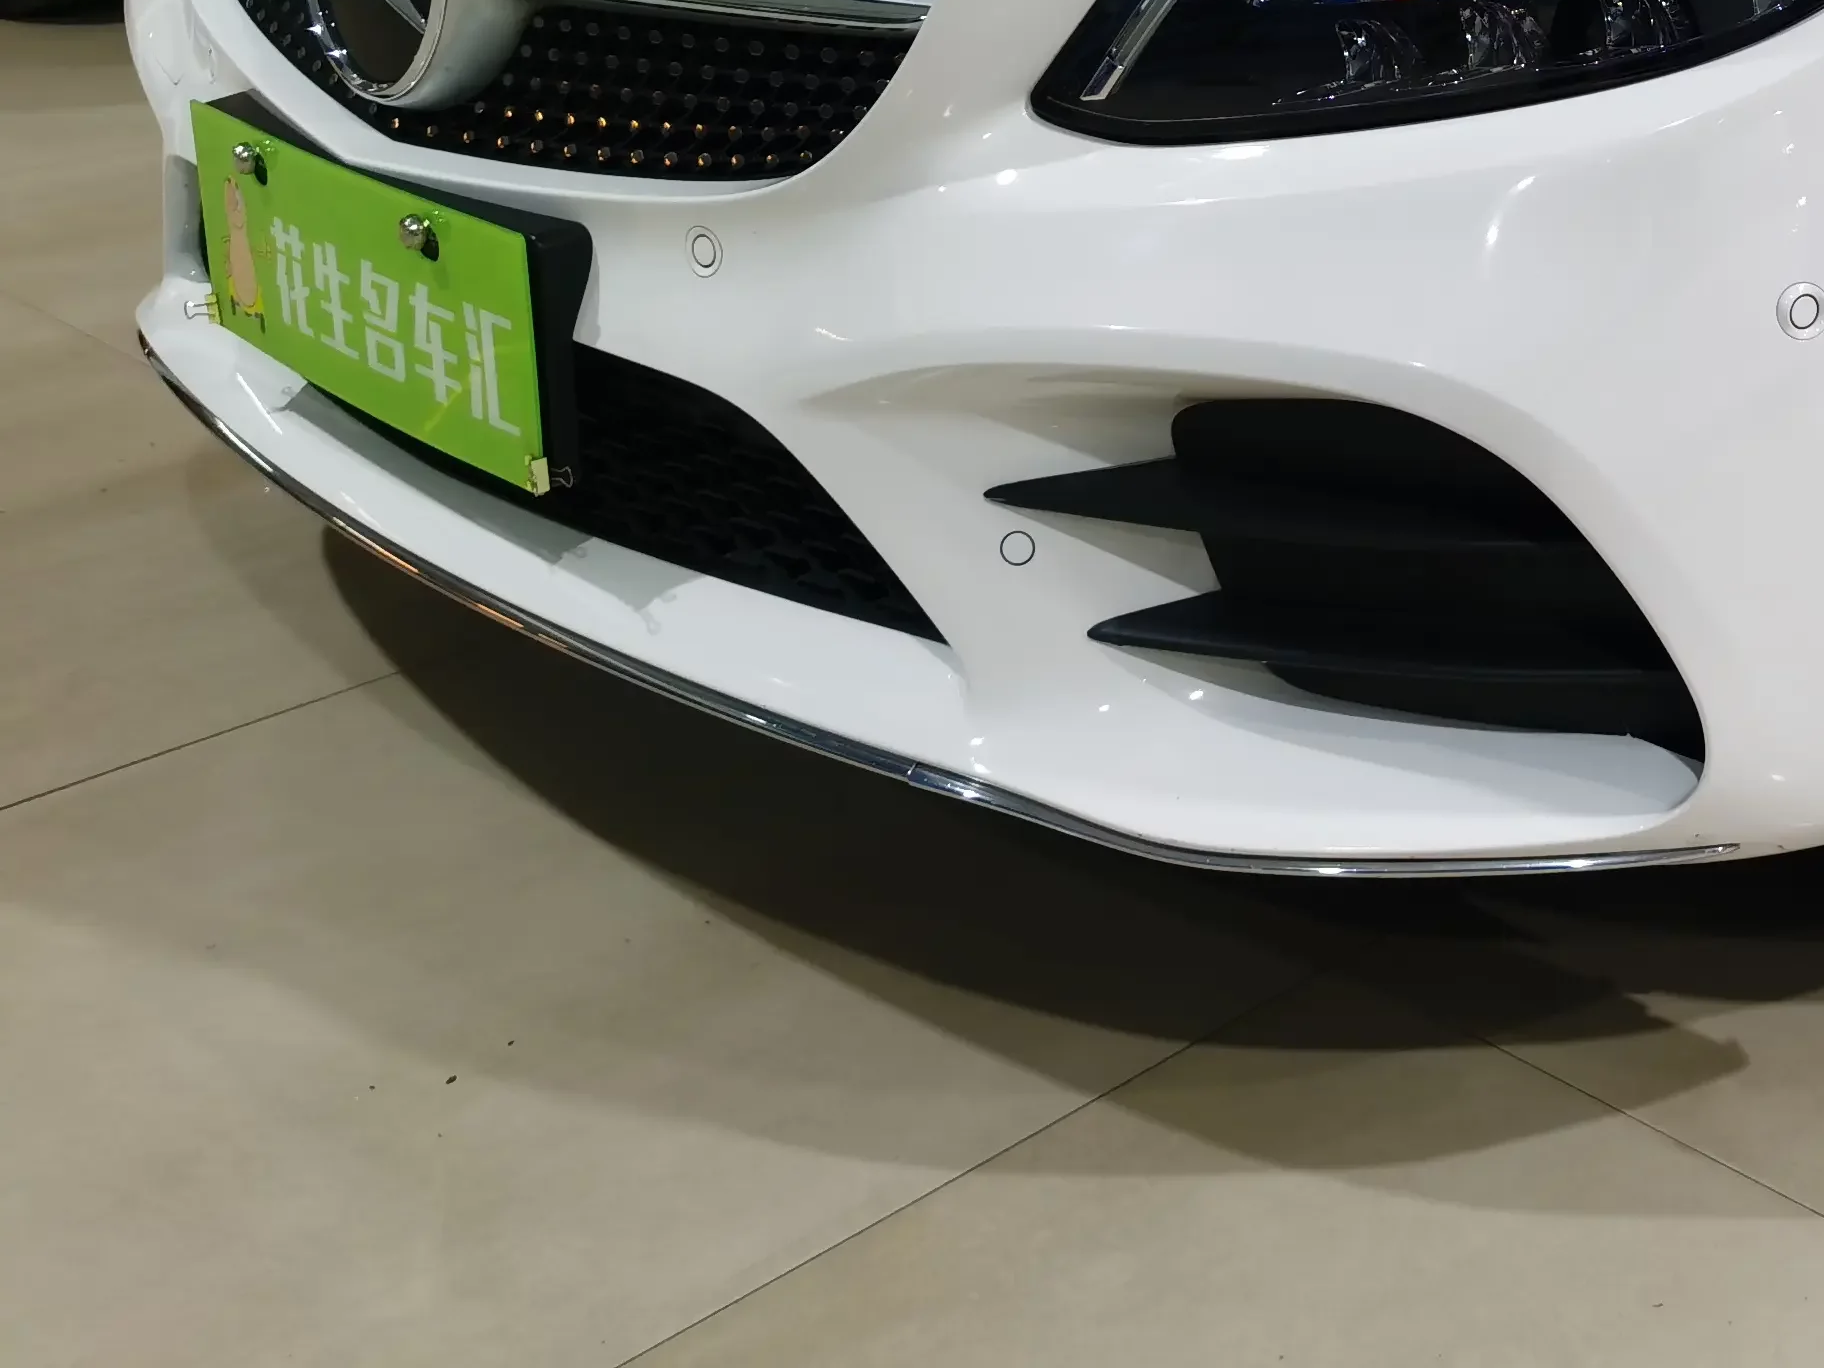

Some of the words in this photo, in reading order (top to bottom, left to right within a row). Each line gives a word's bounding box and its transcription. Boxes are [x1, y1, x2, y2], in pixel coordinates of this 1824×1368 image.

[270, 216, 521, 437] 花生名车汇
